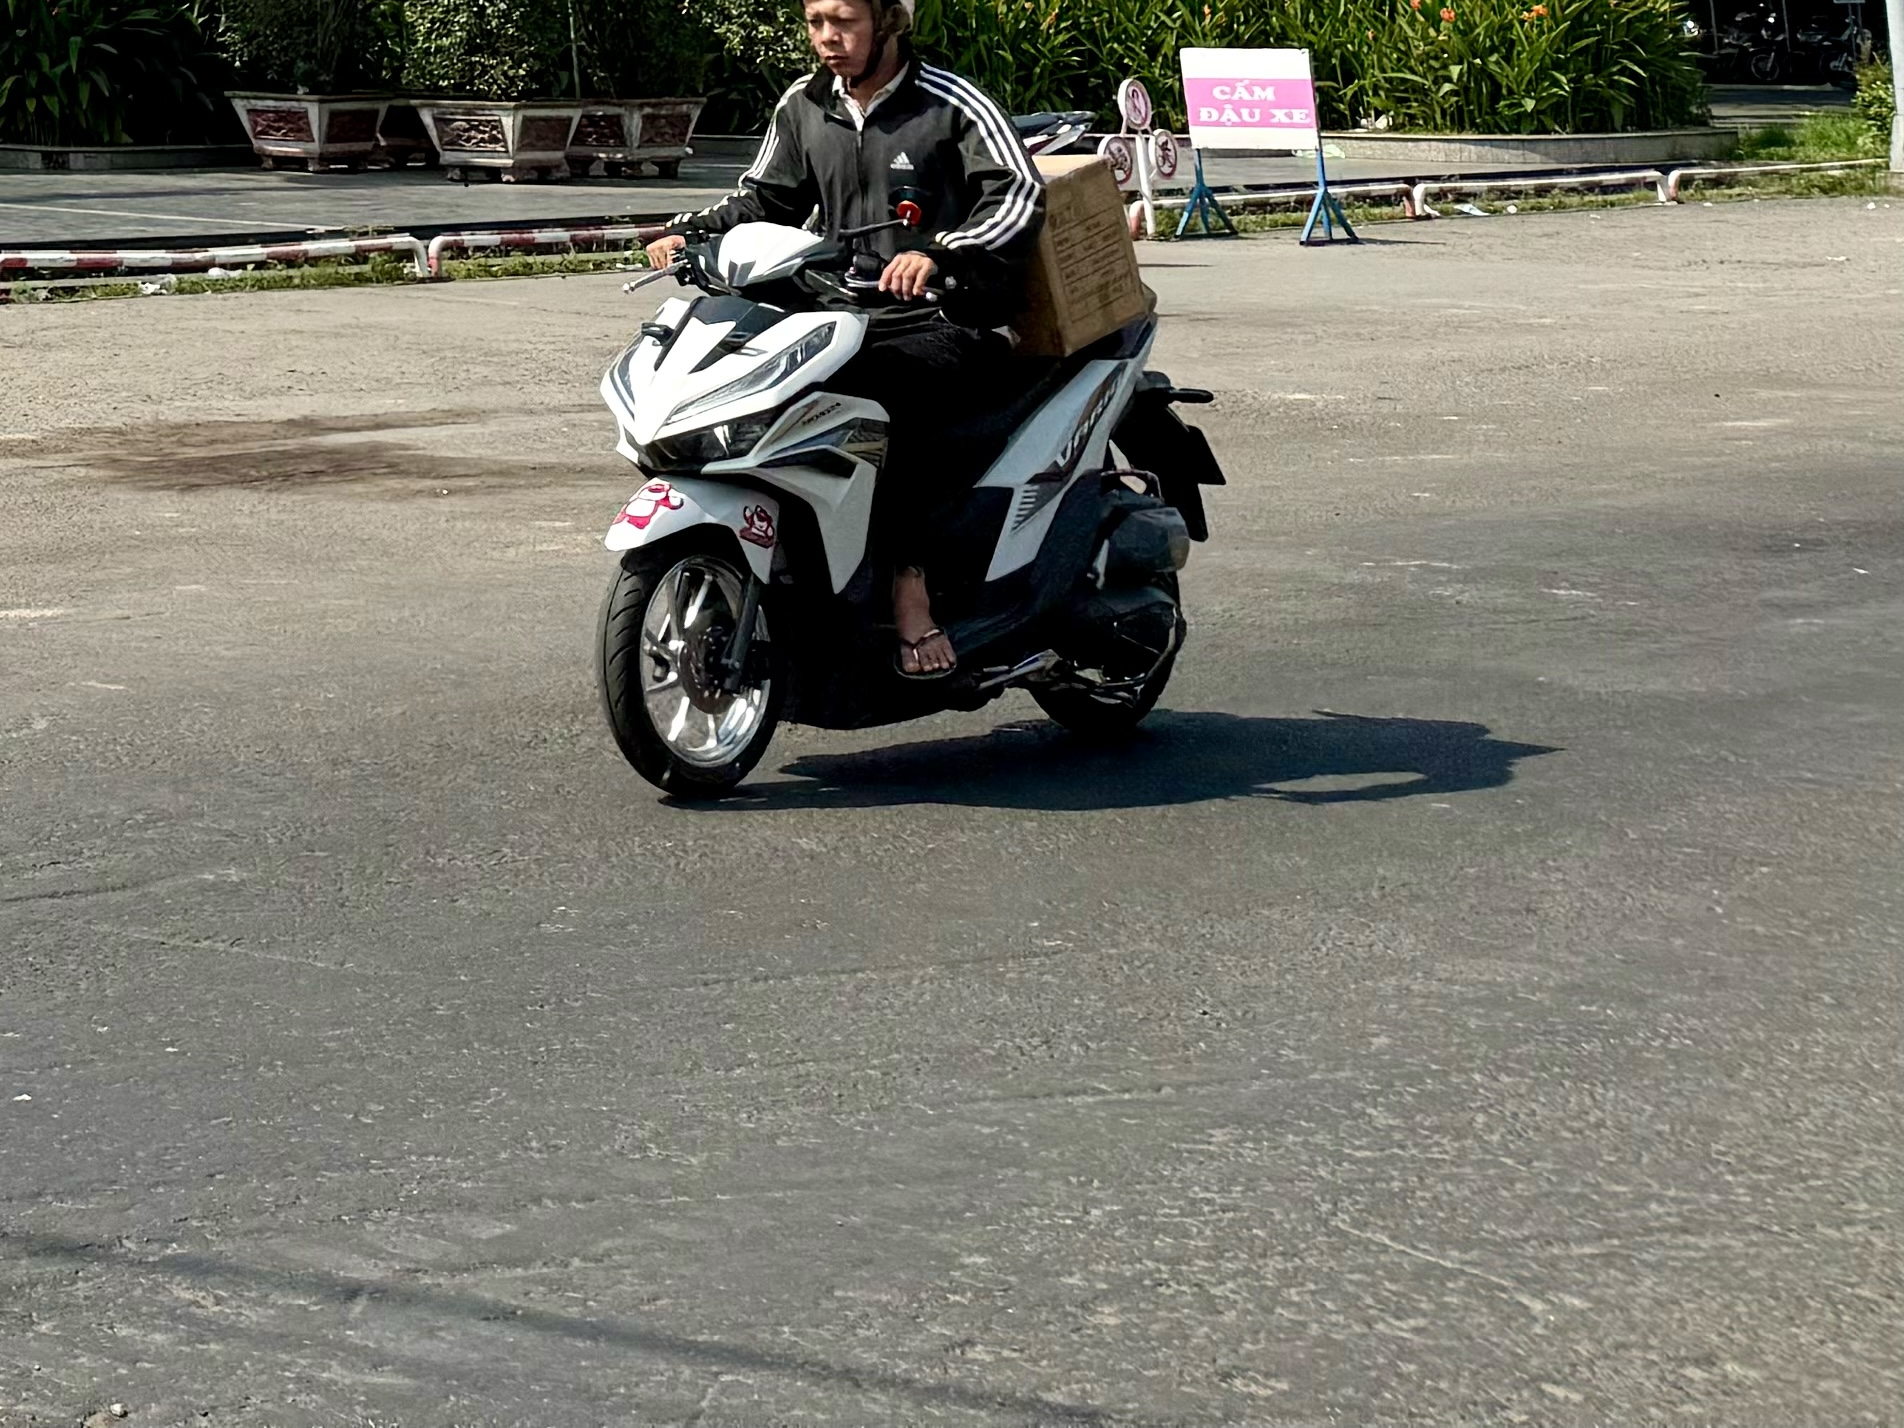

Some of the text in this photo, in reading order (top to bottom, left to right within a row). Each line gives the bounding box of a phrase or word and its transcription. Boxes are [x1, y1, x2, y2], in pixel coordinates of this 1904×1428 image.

[1212, 79, 1276, 101] CẤM
[1199, 104, 1311, 126] ĐẬU XE
